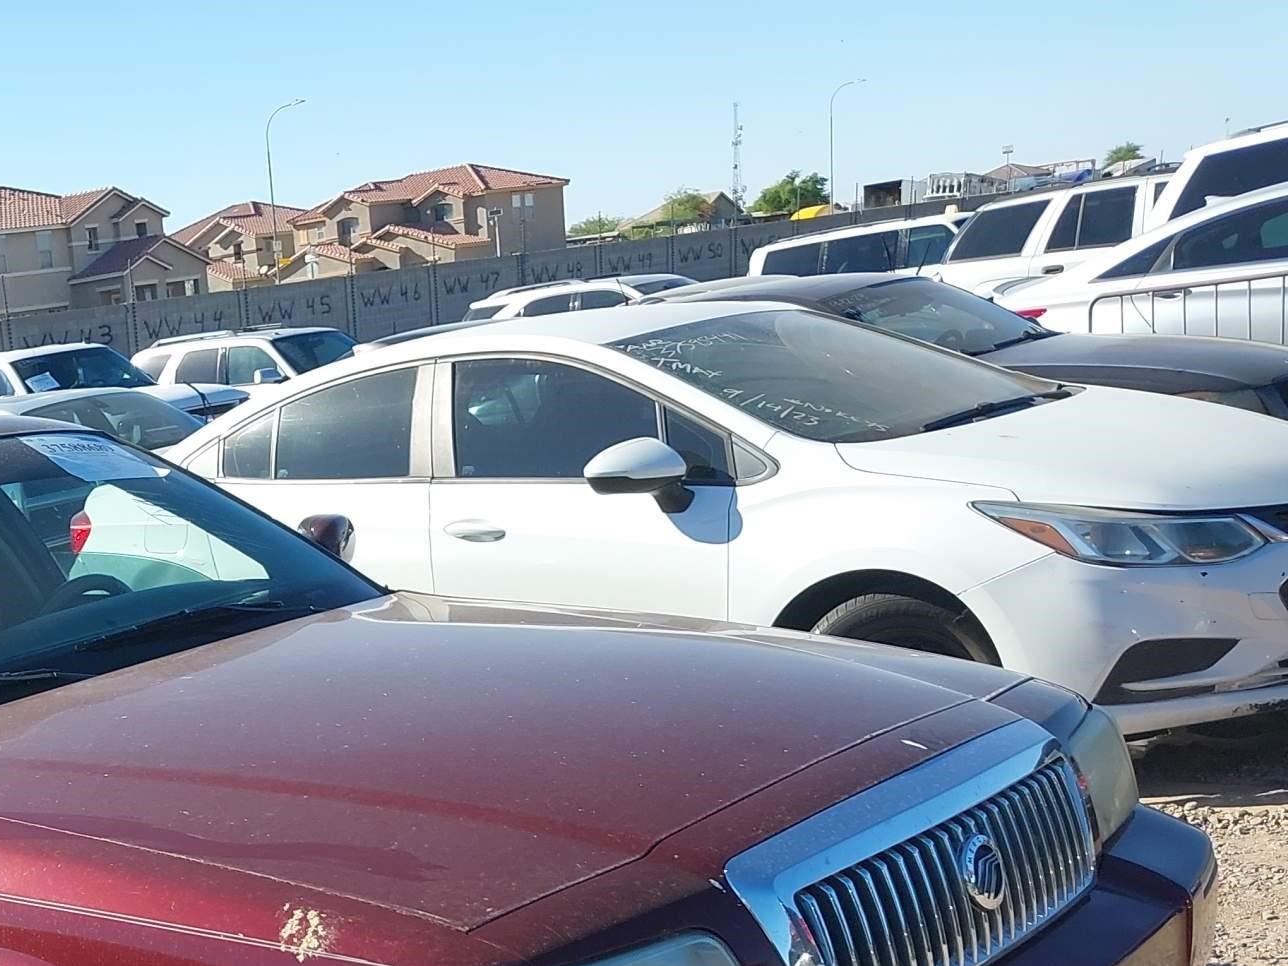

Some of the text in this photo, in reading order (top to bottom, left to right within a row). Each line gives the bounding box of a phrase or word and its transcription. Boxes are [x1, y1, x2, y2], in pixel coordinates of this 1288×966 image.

[608, 252, 653, 274] WW 49
[678, 243, 724, 264] WW 50
[442, 271, 500, 295] WW 47
[530, 260, 583, 283] WW 48
[359, 281, 422, 308] WW 46
[257, 294, 333, 323] WW 45
[143, 310, 224, 340] WW 44
